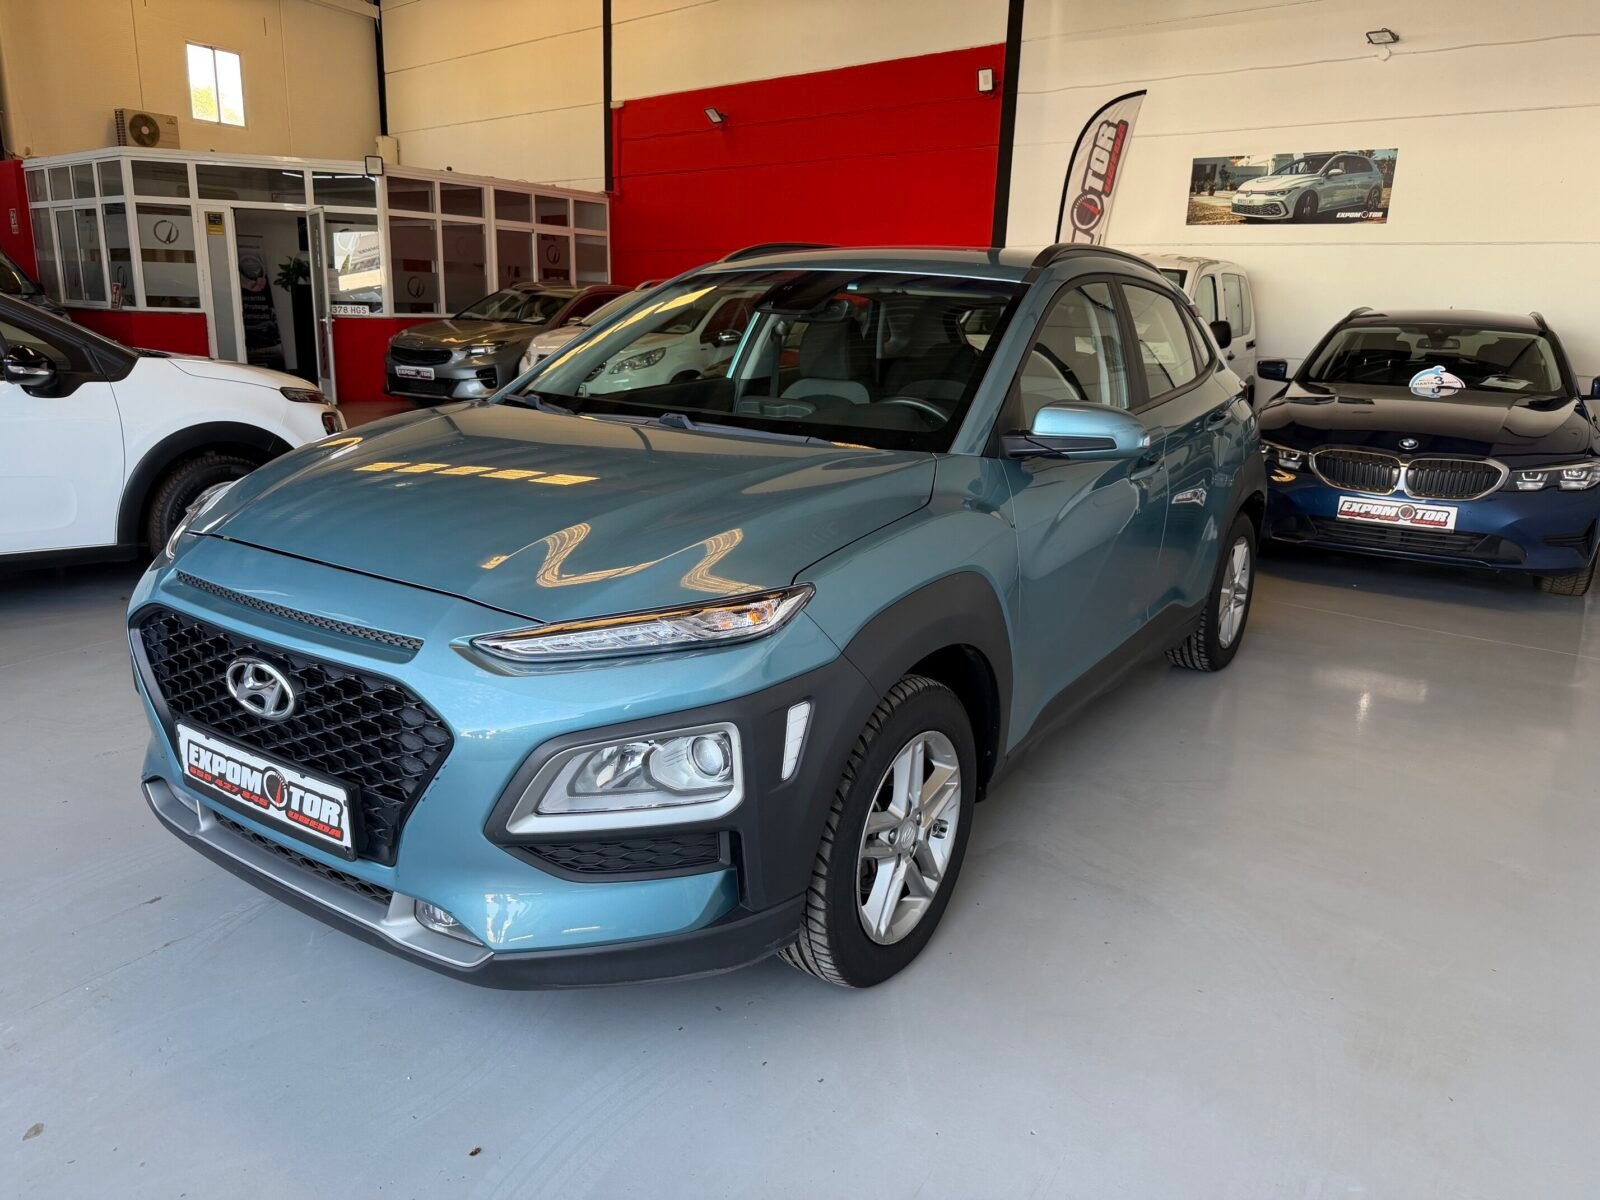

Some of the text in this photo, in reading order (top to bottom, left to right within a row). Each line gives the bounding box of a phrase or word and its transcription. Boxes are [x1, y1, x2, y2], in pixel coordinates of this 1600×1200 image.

[332, 306, 348, 314] 378
[1433, 376, 1445, 385] 3
[189, 743, 341, 827] EXPOMOTOR
[214, 779, 239, 794] 427
[288, 811, 342, 838] UBEDA
